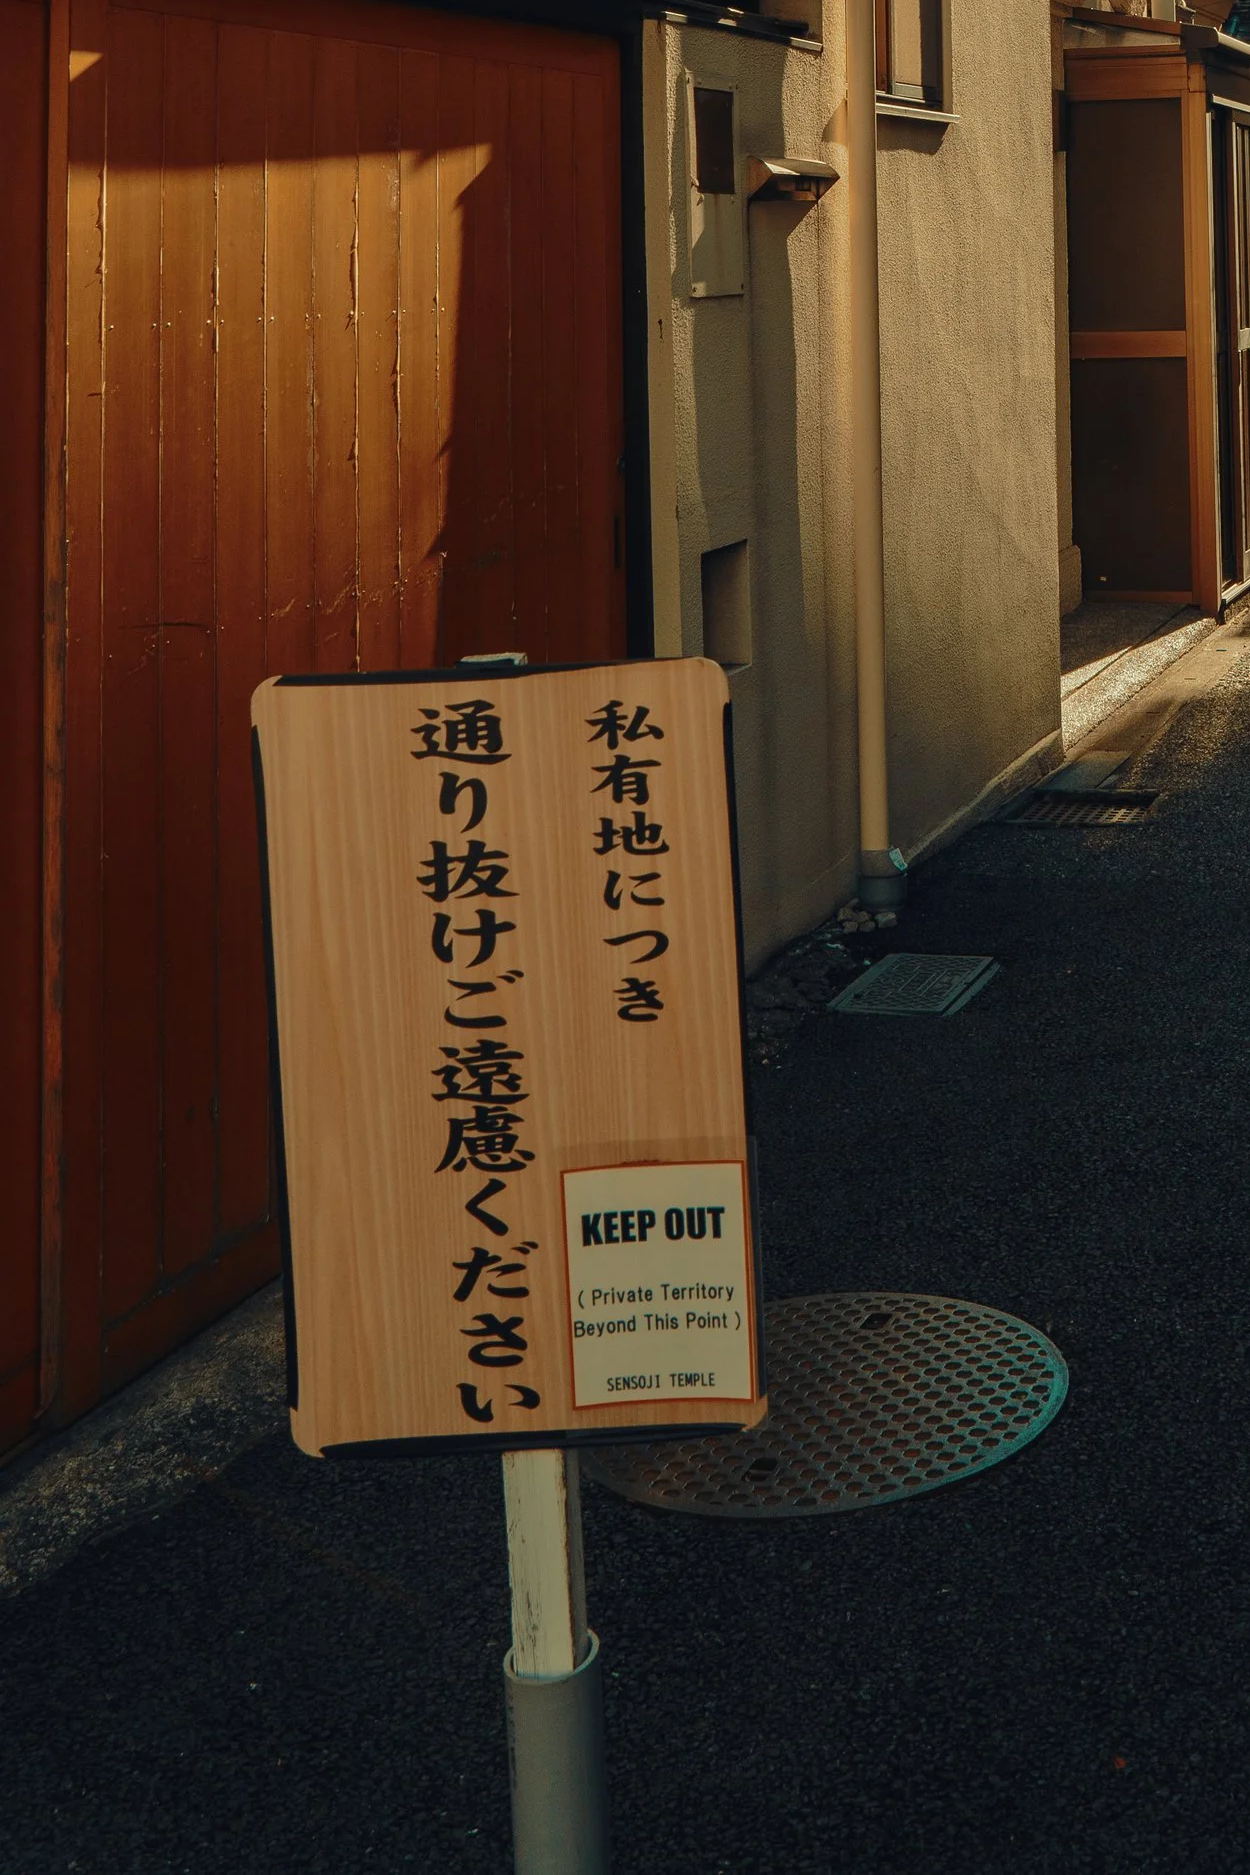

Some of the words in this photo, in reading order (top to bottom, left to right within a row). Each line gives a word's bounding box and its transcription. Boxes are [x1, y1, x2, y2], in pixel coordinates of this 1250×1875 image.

[585, 700, 670, 1021] 私有地につき
[411, 699, 541, 1422] 通り抜けご遠慮ください
[581, 1209, 656, 1247] KEEP
[665, 1206, 725, 1240] OUT
[591, 1286, 653, 1306] Private
[660, 1282, 734, 1301] Territory
[573, 1316, 636, 1338] Beyond
[644, 1313, 679, 1331] This
[686, 1312, 728, 1329] Point
[607, 1375, 660, 1392] SENSOJI
[670, 1373, 715, 1387] TEMPLE
